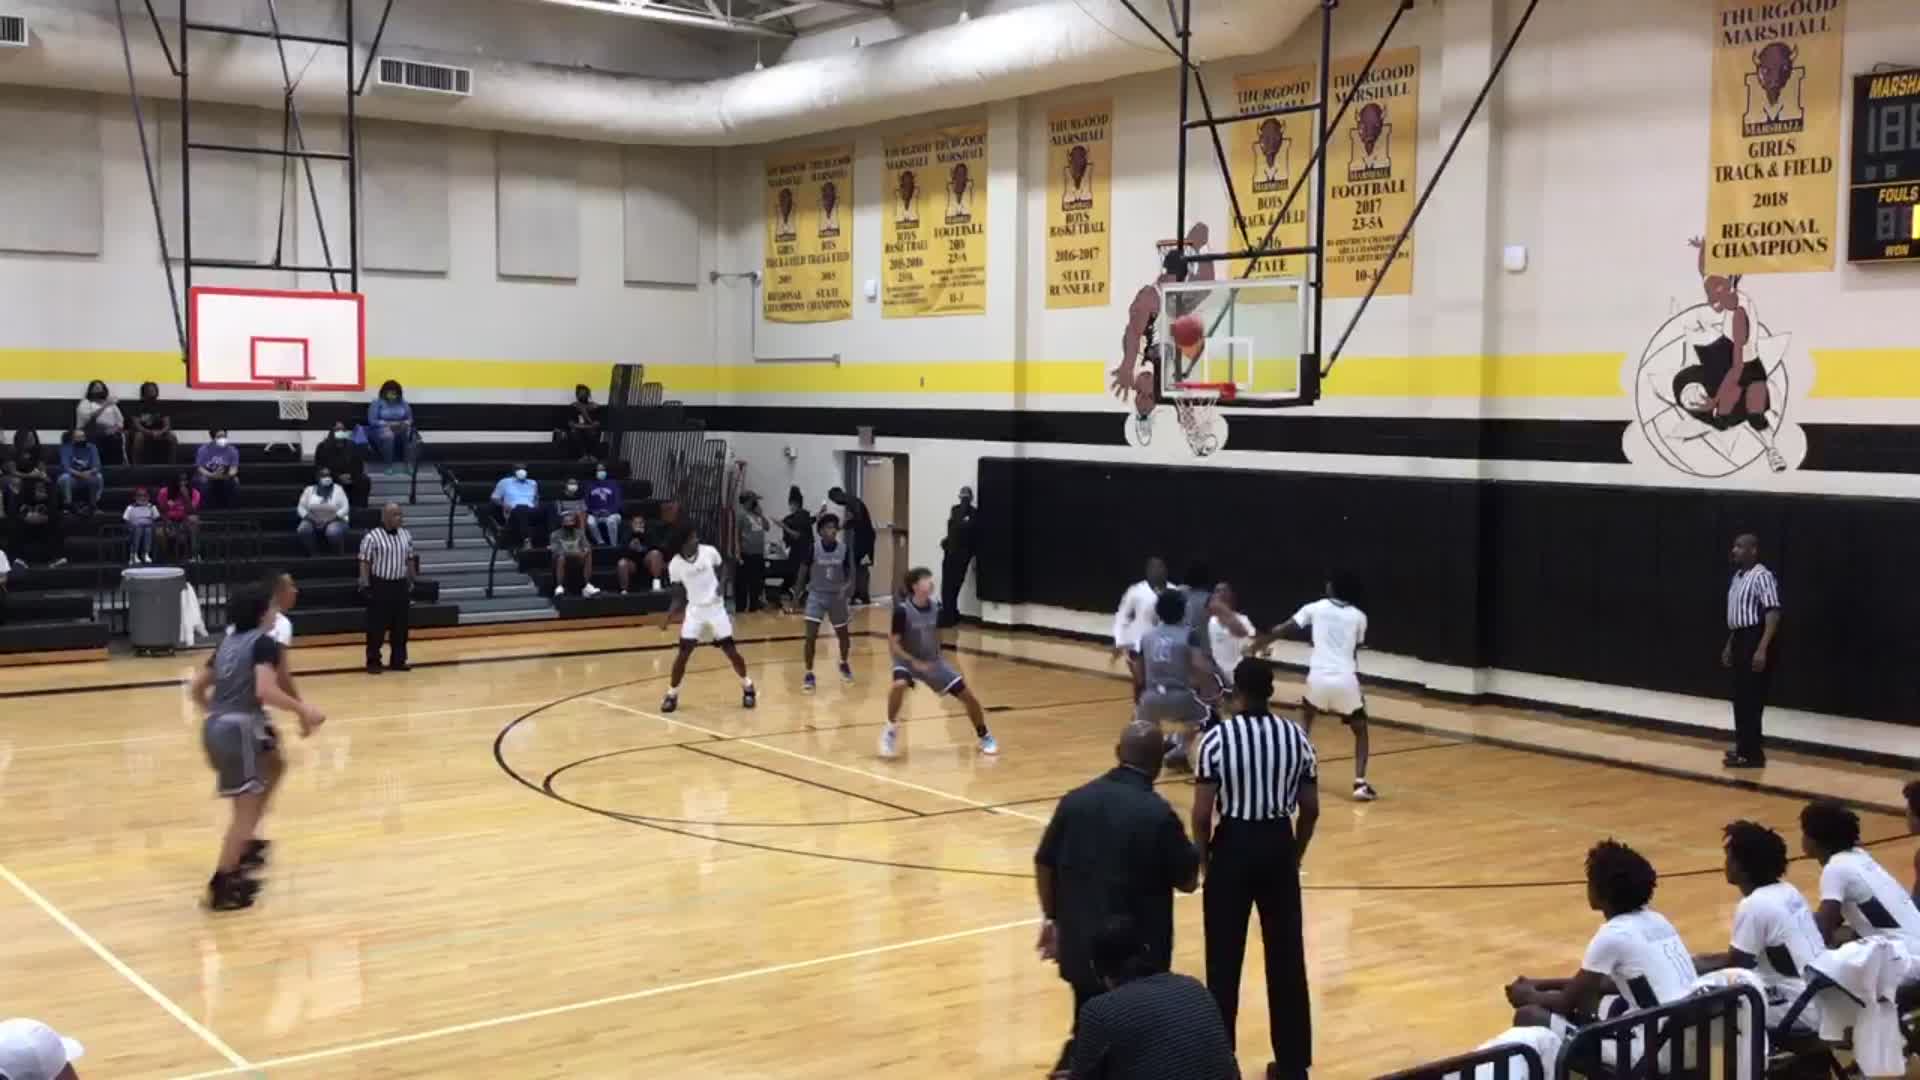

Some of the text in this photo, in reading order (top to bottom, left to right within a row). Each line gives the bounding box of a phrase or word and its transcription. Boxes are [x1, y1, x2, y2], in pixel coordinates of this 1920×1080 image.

[1720, 0, 1839, 27] THURGOOD
[1722, 16, 1830, 46] MARSHALL
[1237, 81, 1310, 104] THURGOOD
[1748, 139, 1796, 158] GIRLS
[1715, 157, 1833, 182] TRACK & FIELD
[1331, 180, 1407, 199] FOOTBALL
[1878, 186, 1919, 203] FOULS
[1355, 198, 1382, 215] 2017
[1752, 192, 1789, 208] 2018
[1065, 212, 1091, 225] BOYS
[1352, 218, 1383, 231] 23-5A
[1721, 218, 1820, 239] REGIONAL
[1712, 237, 1828, 259] CHAMPIONS
